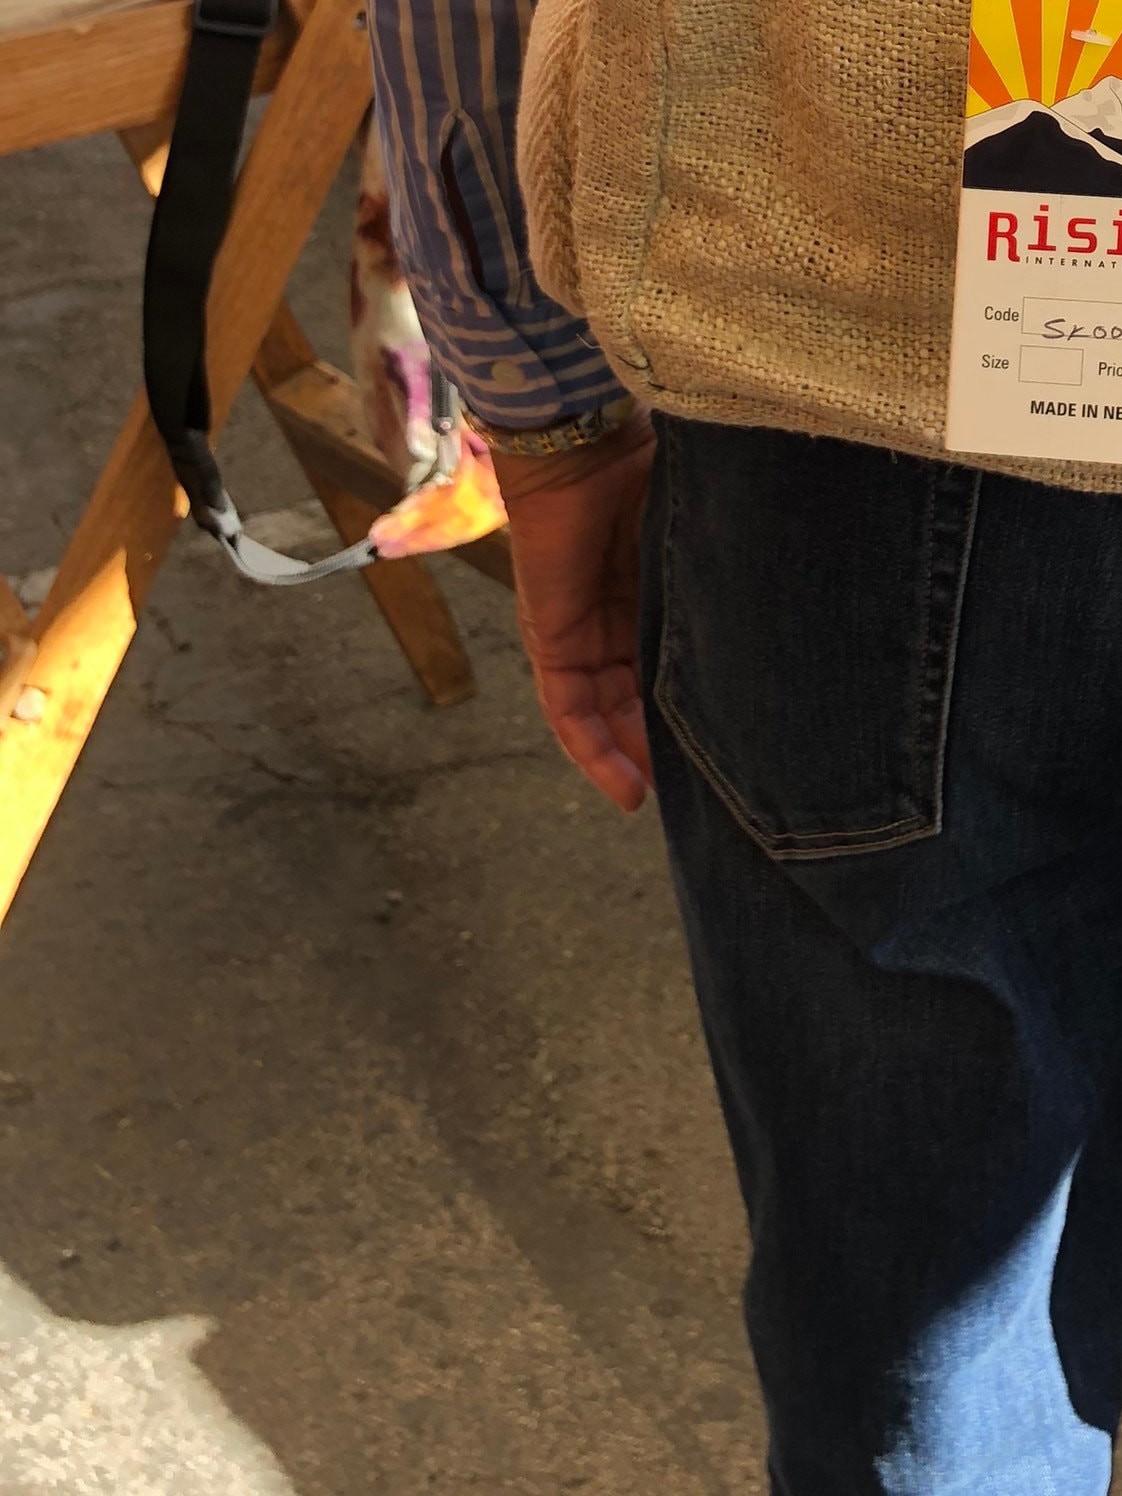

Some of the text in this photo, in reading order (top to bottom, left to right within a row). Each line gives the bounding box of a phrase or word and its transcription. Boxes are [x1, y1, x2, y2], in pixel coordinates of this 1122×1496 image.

[984, 306, 1019, 321] Code
[981, 354, 1009, 369] Size
[1030, 400, 1076, 417] MADE
[1081, 404, 1098, 418] IN
